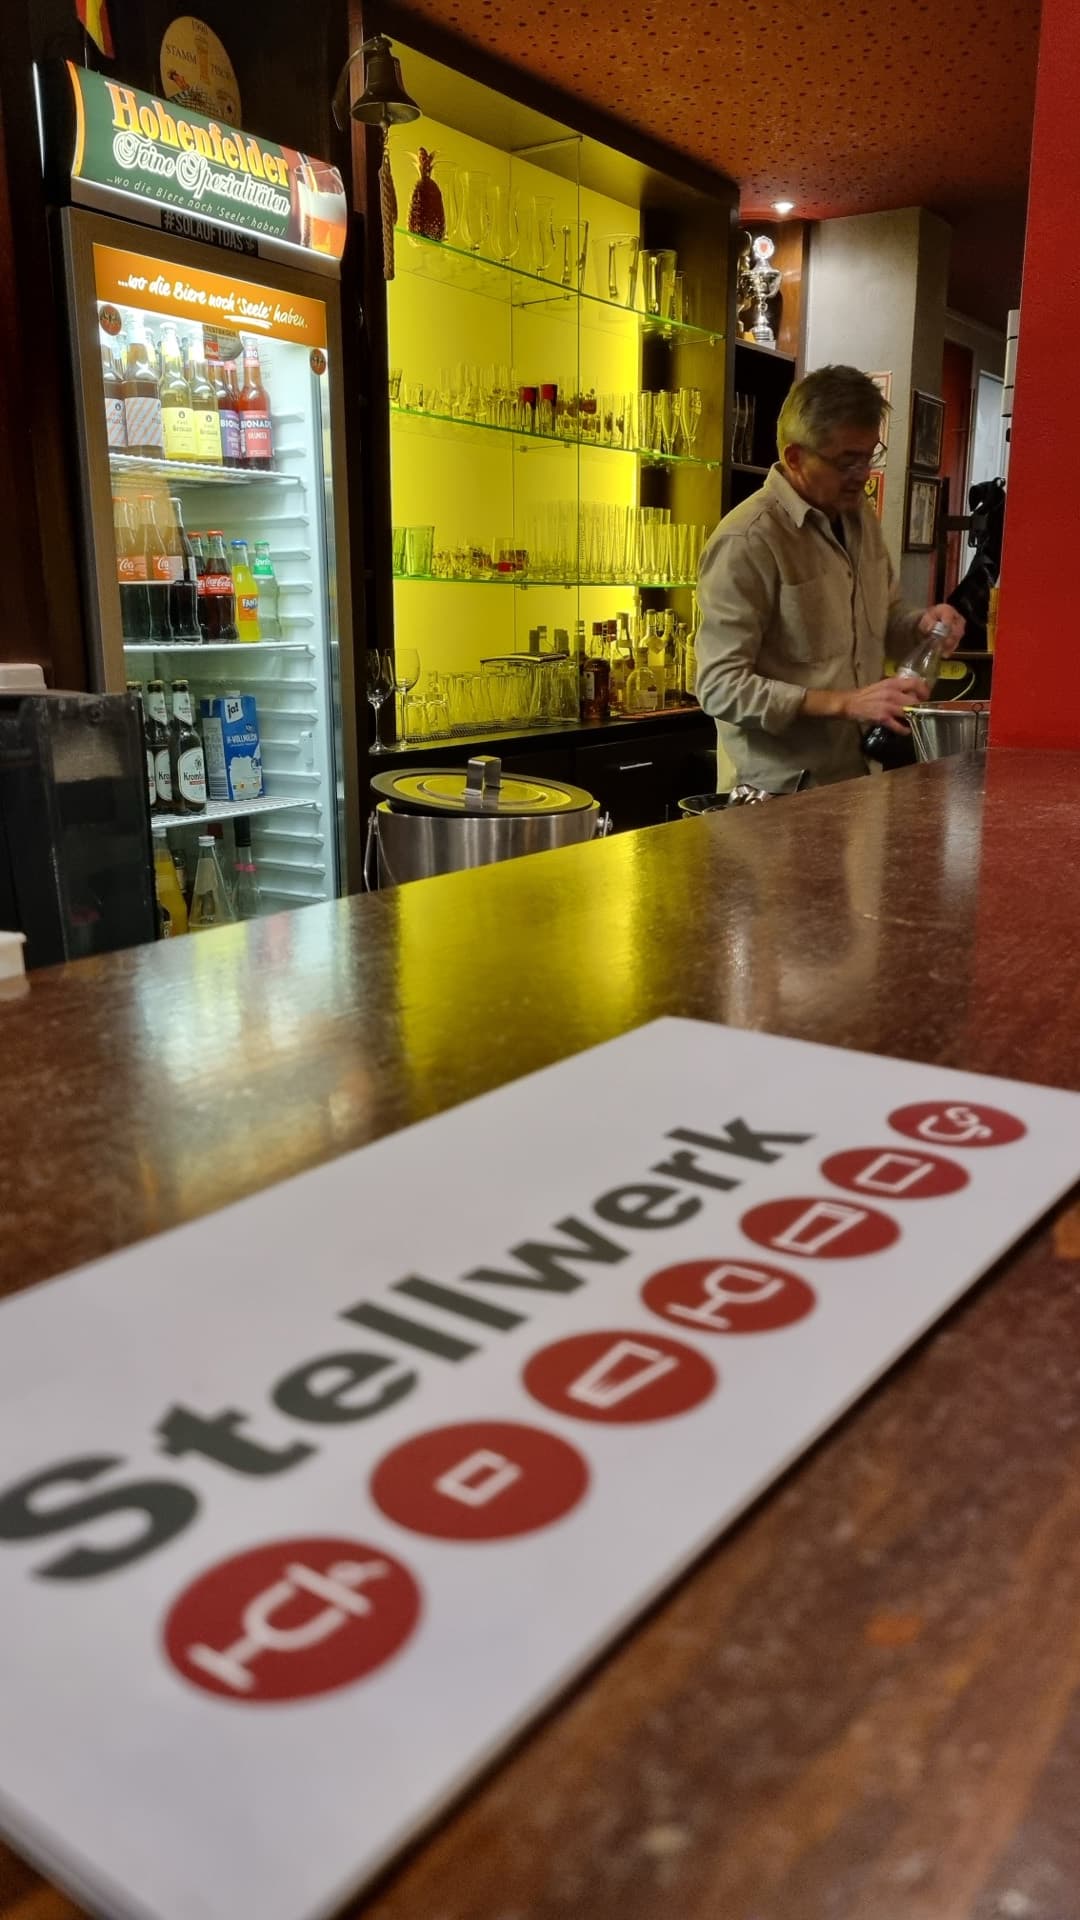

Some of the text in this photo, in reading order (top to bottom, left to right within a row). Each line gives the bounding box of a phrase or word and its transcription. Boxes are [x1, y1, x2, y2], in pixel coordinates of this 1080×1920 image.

[165, 44, 197, 65] STAMM
[105, 81, 289, 187] Hohenfelder
[113, 131, 291, 216] Feine Spezialitäten
[134, 180, 151, 195] die
[156, 187, 184, 205] Biere
[187, 199, 213, 214] noch
[250, 216, 286, 237] haben!
[149, 275, 171, 297] die
[173, 281, 206, 305] Biere
[208, 292, 235, 313] noch
[227, 702, 239, 719] ja!
[0, 1115, 818, 1582] Stellwerk
